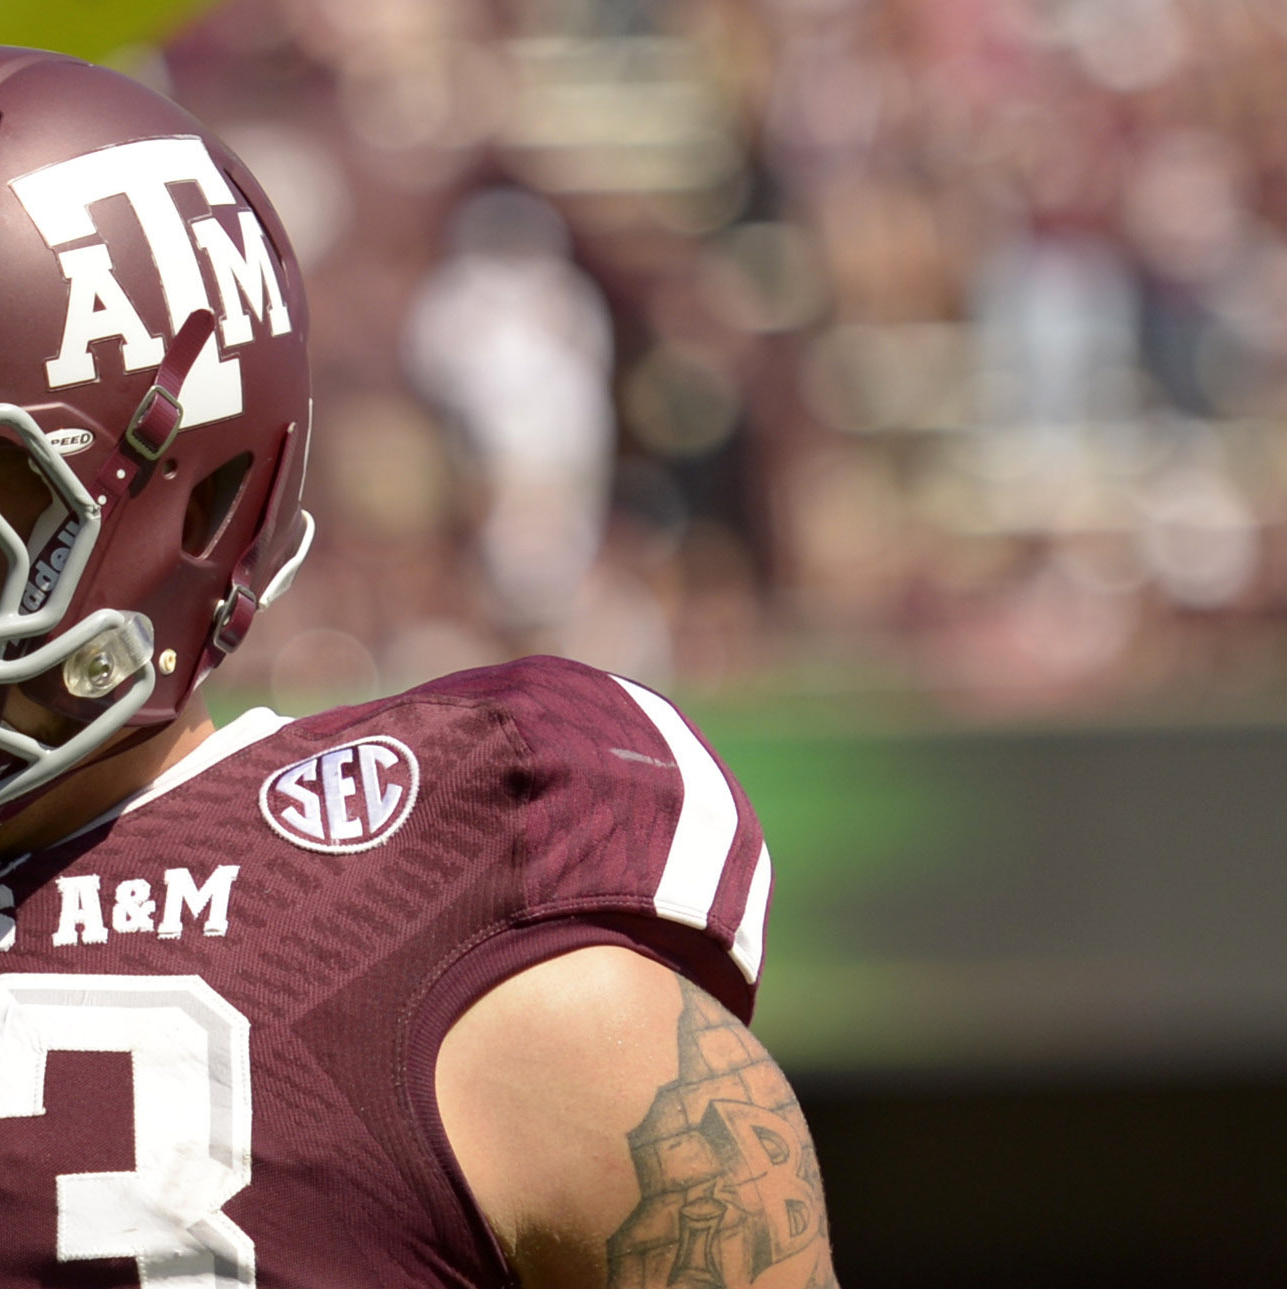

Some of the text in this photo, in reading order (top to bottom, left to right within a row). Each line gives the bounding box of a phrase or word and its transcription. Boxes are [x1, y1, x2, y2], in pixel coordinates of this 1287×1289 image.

[50, 433, 91, 446] PEED
[273, 743, 407, 839] SEC
[52, 865, 240, 946] A&M
